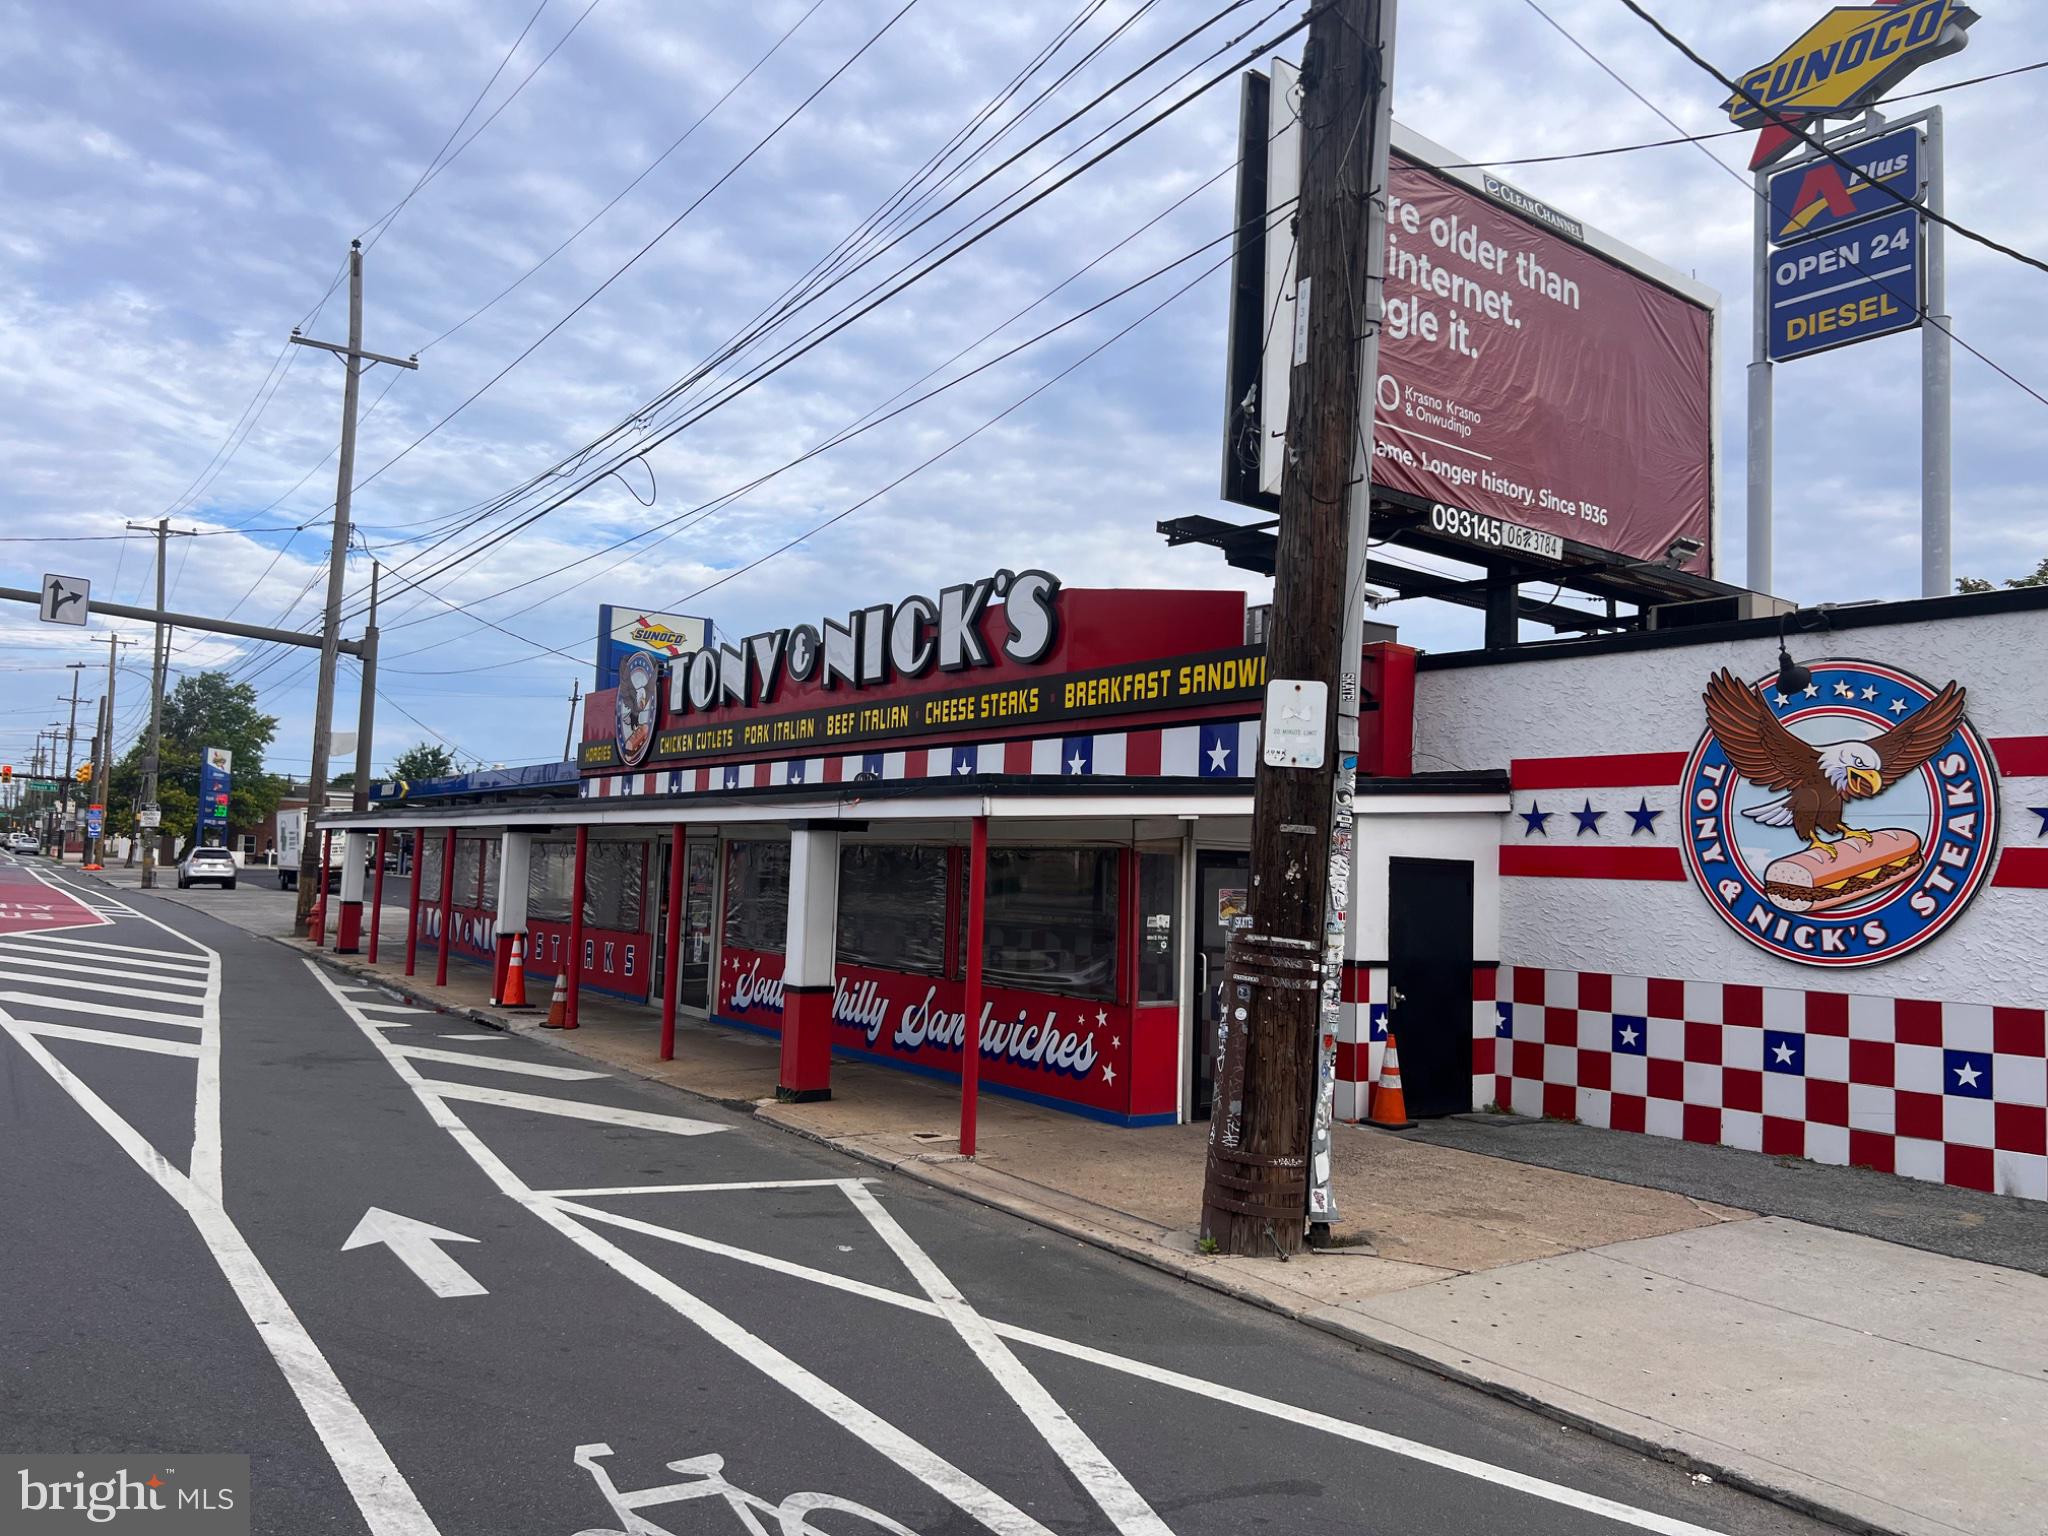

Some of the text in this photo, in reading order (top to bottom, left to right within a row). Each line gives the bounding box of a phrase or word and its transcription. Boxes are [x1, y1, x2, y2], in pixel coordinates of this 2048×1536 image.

[1732, 0, 1946, 114] SUNOCO
[1849, 154, 1909, 186] Plus
[1389, 233, 1521, 329] internet.
[1430, 214, 1508, 275] older
[1516, 251, 1580, 310] than
[1775, 226, 1910, 287] OPEN 24
[1449, 309, 1478, 359] it.
[1786, 293, 1899, 342] DIESEL
[1405, 385, 1481, 424] Krasno Krasno
[1405, 403, 1472, 438] & Onwudinjo
[1422, 452, 1478, 486] Longer
[1482, 469, 1535, 504] history.
[1539, 488, 1576, 516] Since
[1579, 501, 1608, 526] 1936
[1432, 503, 1501, 546] 093145
[634, 628, 684, 645] SUNOCO
[668, 569, 1061, 715] TONY & NICK'S
[1064, 668, 1171, 709] BREAKFAST
[659, 734, 694, 755] CHICKEN
[696, 728, 734, 750] CUTLETS
[744, 723, 770, 745] PORK
[773, 718, 815, 741] ITALIAN
[826, 711, 855, 736] BEEF
[859, 705, 909, 732] ITALIAN
[925, 696, 976, 724] CHEESE
[981, 688, 1039, 717] STEAKS
[1282, 728, 1301, 736] MINUTE
[1696, 753, 1978, 954] TONY & NICK'S STEAKS
[426, 906, 464, 943] TOY
[534, 930, 636, 977] STAKS
[831, 974, 890, 1042] hilly
